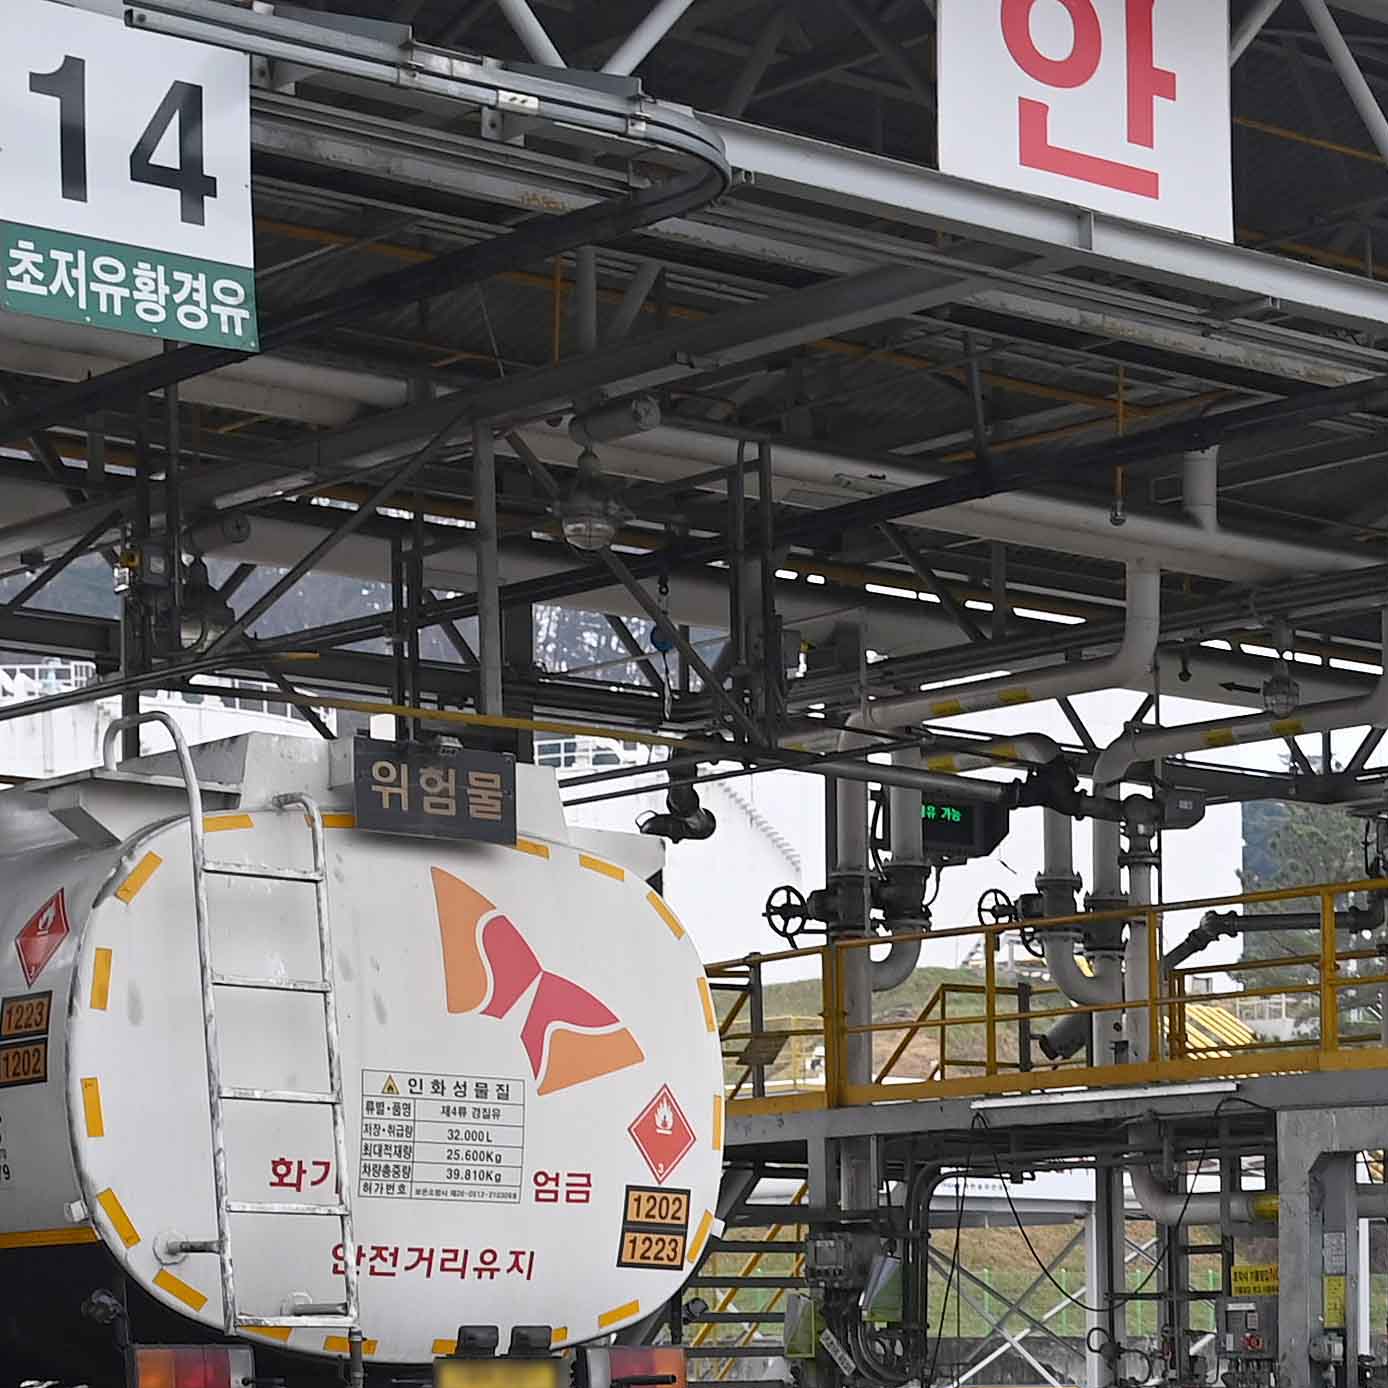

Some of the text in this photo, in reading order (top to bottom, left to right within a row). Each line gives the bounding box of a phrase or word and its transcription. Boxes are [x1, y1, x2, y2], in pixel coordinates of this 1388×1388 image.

[1000, 0, 1177, 200] 안
[28, 54, 217, 226] 14
[5, 239, 250, 336] 초저유황경유
[371, 759, 504, 822] 위험물
[5, 1002, 46, 1034] 1223
[408, 1076, 510, 1101] 인화성물질
[446, 1148, 502, 1164] 25.600Kg
[656, 1162, 665, 1175] 3
[446, 1166, 502, 1184] 39.810Kg
[532, 1169, 594, 1204] 엄금
[633, 1194, 683, 1221] 1202
[330, 1242, 536, 1282] 안전거리유지
[627, 1234, 680, 1263] 1223
